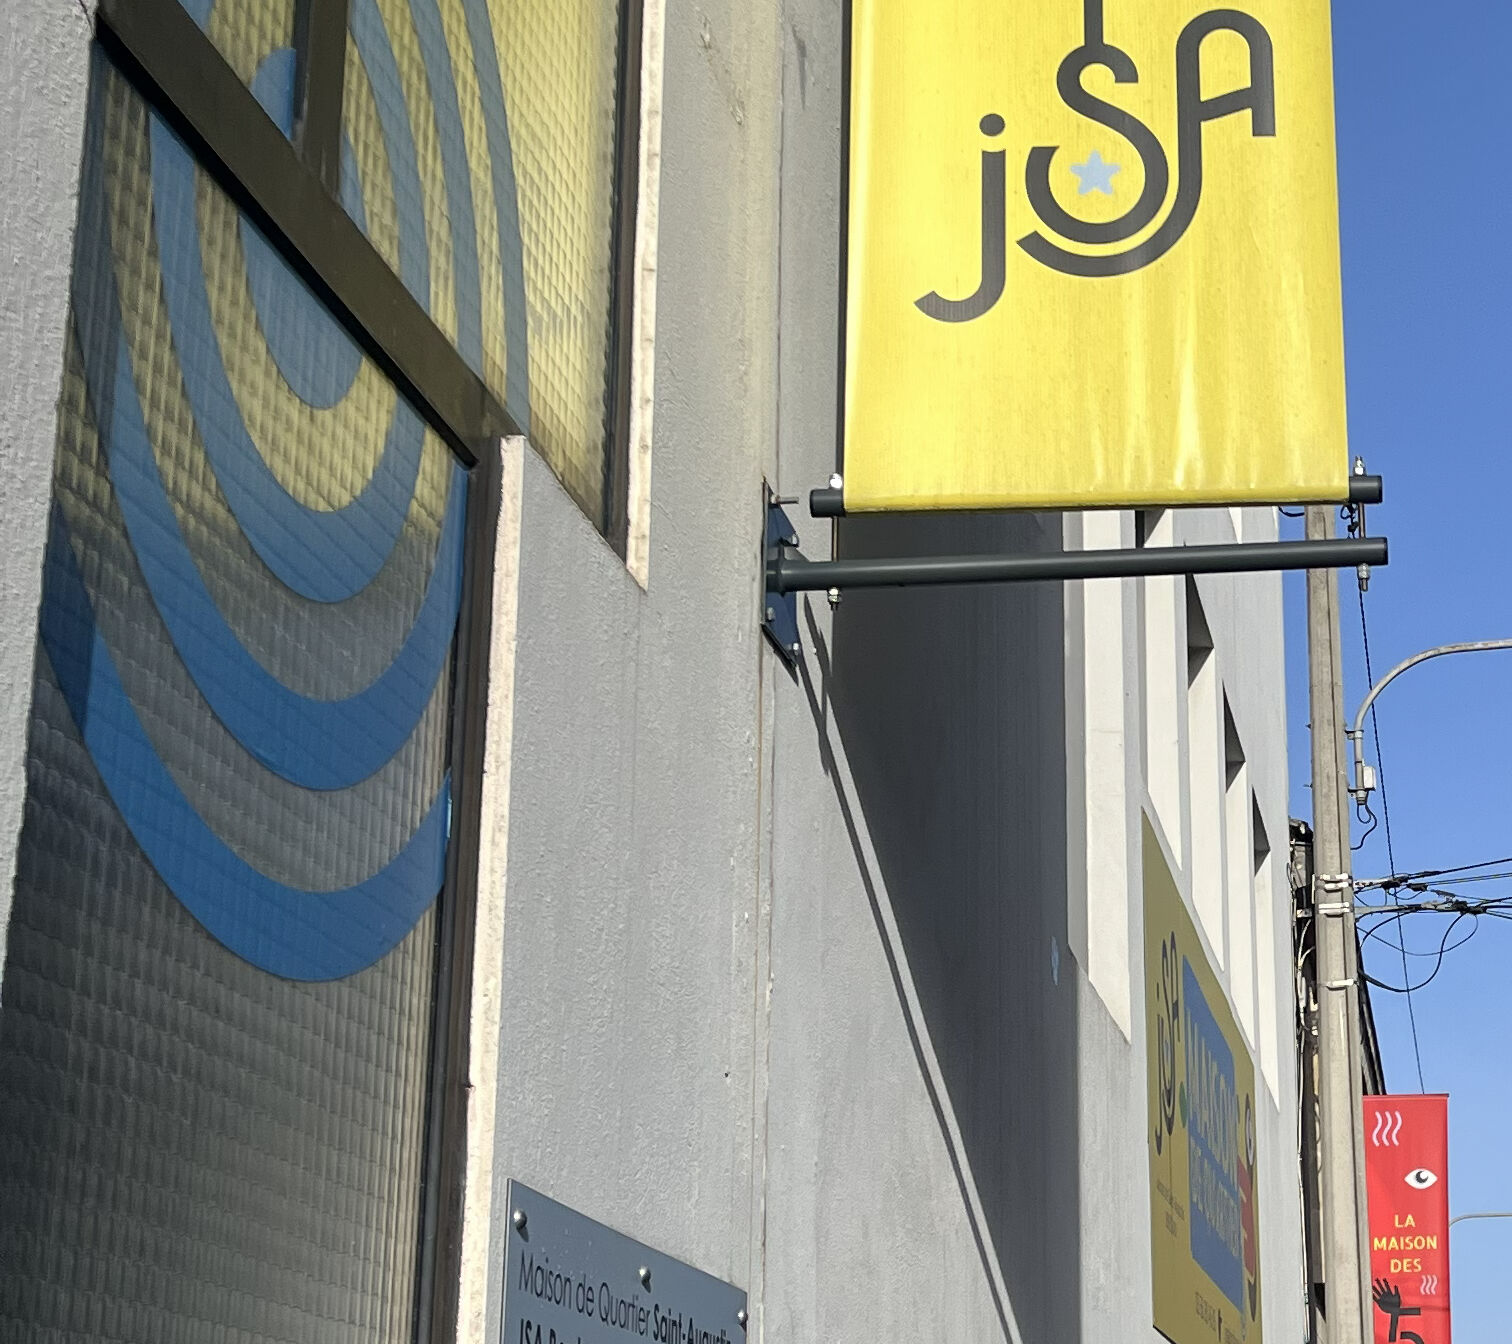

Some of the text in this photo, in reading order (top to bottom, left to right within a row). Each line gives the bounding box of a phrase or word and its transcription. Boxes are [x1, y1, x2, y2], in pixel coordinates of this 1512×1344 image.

[1394, 1213, 1416, 1228] LA
[1373, 1235, 1438, 1251] MAISON
[1390, 1258, 1422, 1273] DES
[519, 1249, 573, 1311] Maison
[575, 1273, 595, 1318] de
[599, 1282, 651, 1337] Quartier
